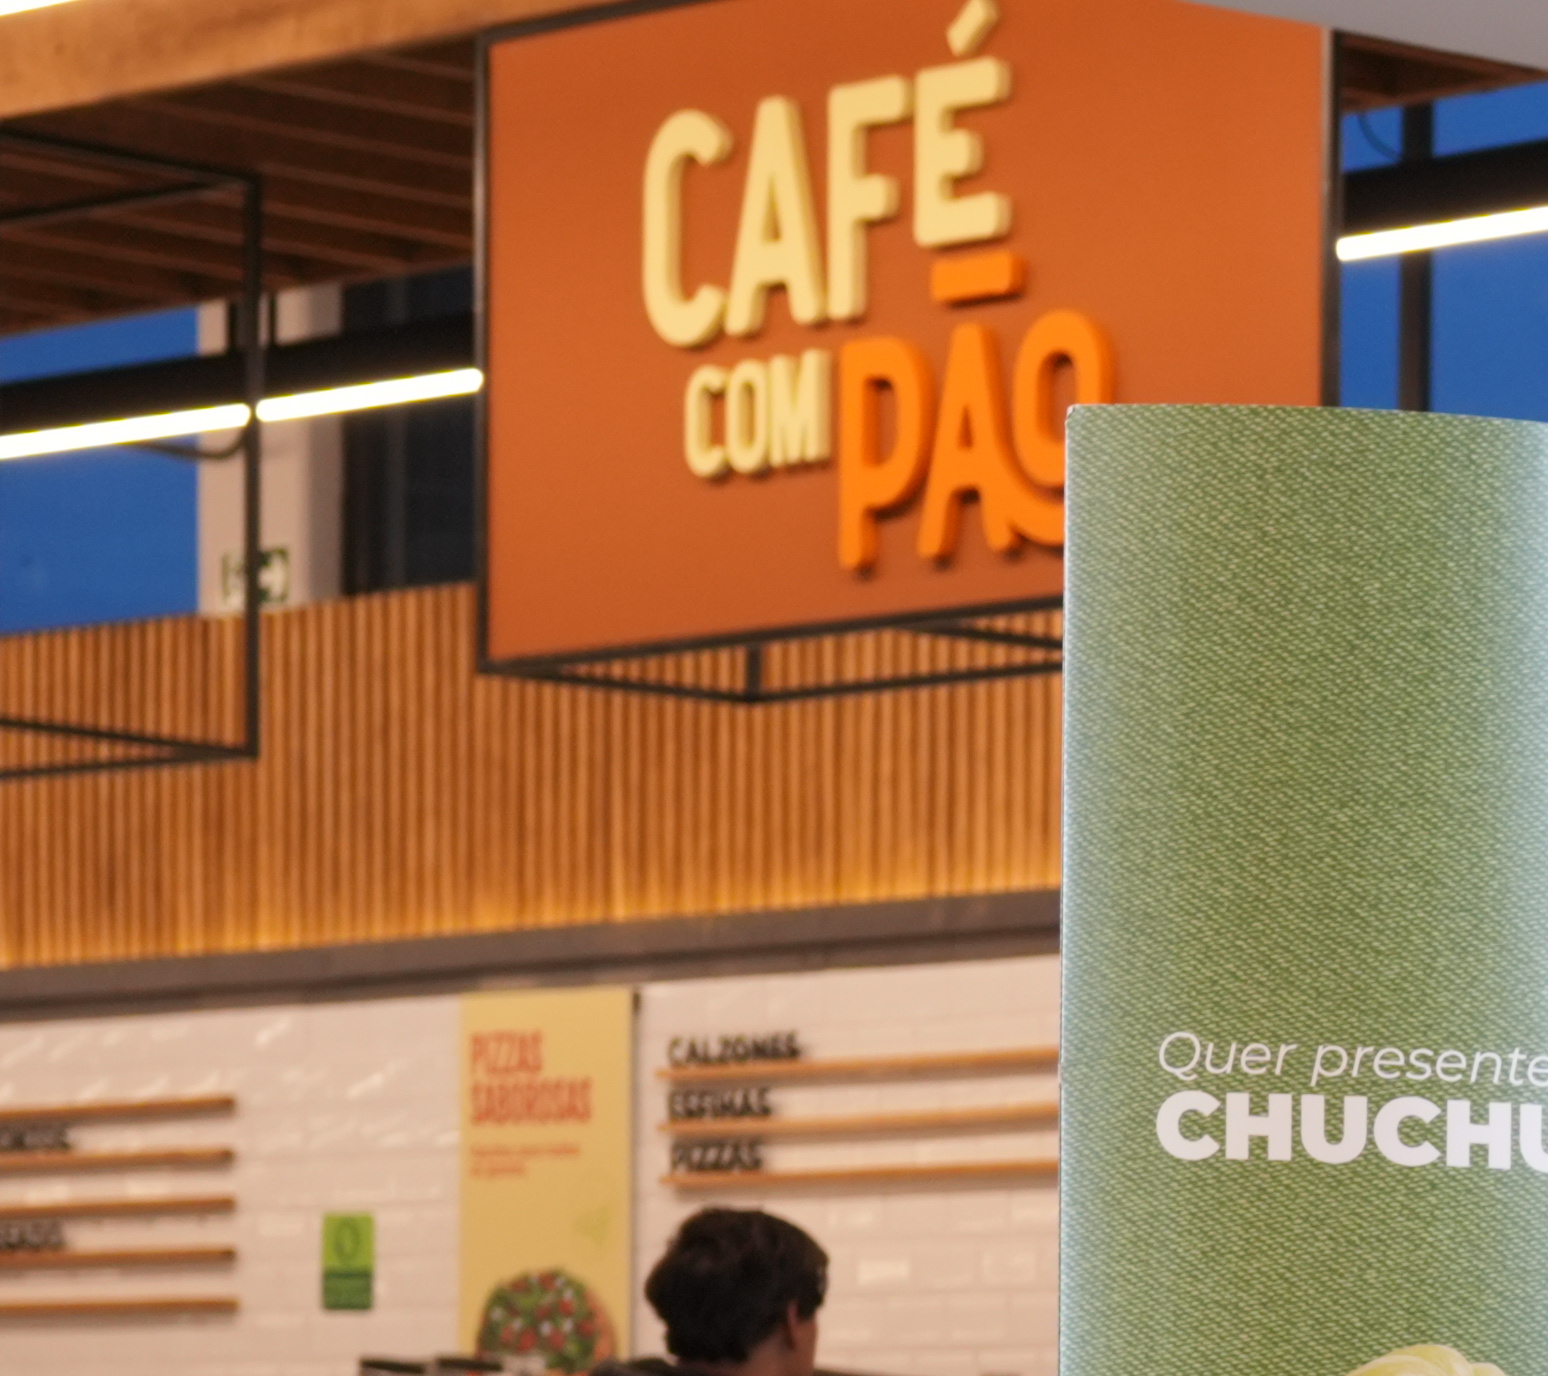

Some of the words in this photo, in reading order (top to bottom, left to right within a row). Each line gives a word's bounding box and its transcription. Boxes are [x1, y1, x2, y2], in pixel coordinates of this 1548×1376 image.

[642, 0, 1010, 348] CAFÉ
[685, 348, 831, 478] COM
[838, 249, 1113, 572] PÃO
[1158, 1031, 1296, 1080] Quer
